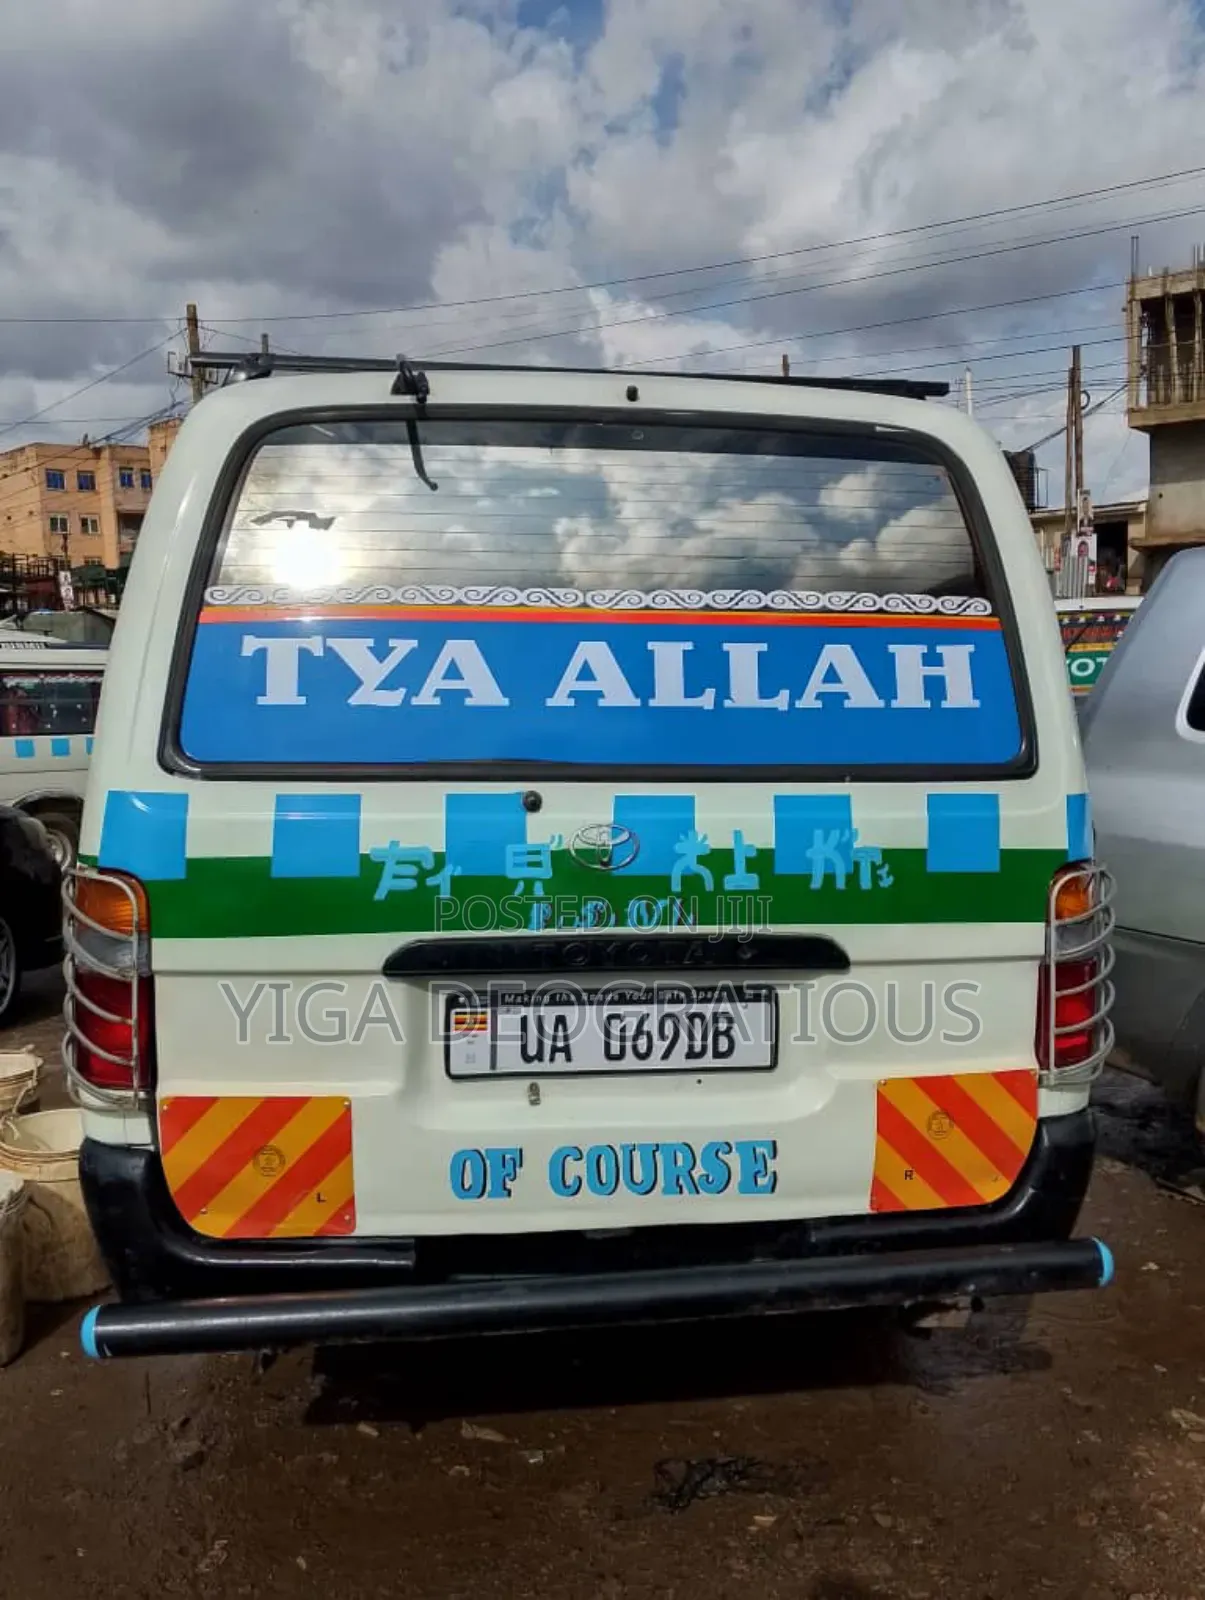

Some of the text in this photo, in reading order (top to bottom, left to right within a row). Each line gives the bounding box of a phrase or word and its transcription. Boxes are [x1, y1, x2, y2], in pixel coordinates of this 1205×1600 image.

[240, 635, 980, 711] TYA ALLAH
[533, 940, 713, 964] TOYOTA
[520, 1011, 736, 1063] UA 069DB
[450, 1140, 777, 1200] OF COURSE
[904, 1169, 914, 1181] R
[316, 1192, 327, 1204] L
